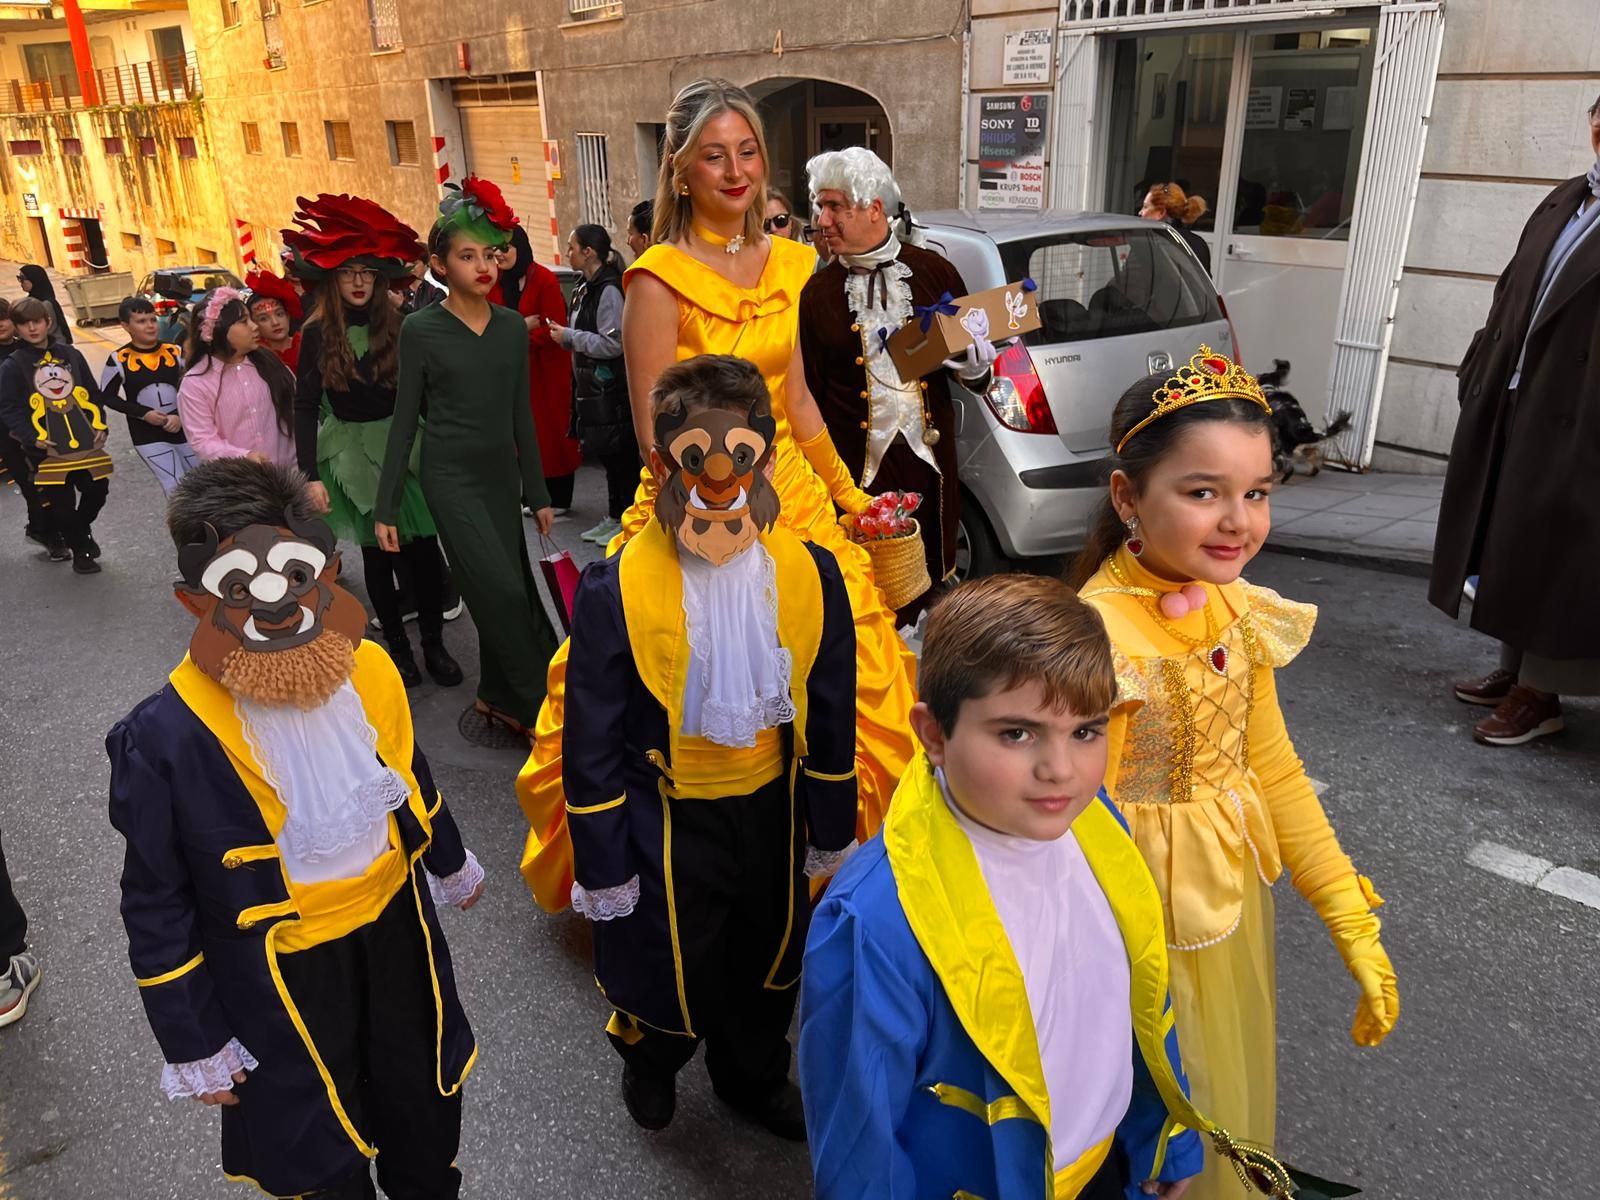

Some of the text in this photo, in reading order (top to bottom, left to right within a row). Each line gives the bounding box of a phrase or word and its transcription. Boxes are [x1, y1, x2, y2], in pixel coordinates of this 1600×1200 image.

[773, 29, 783, 58] 4
[986, 101, 1016, 111] SAMSUNG
[1034, 96, 1047, 110] LG
[981, 119, 1015, 129] SONY
[982, 132, 1016, 144] PHILIPS
[980, 145, 1016, 157] Hisense
[1020, 173, 1041, 181] BOSCH
[1000, 184, 1021, 192] KRUPS
[1022, 184, 1041, 192] Tefal
[1008, 196, 1038, 205] KENWOOD
[1044, 354, 1081, 366] HYUNDAI
